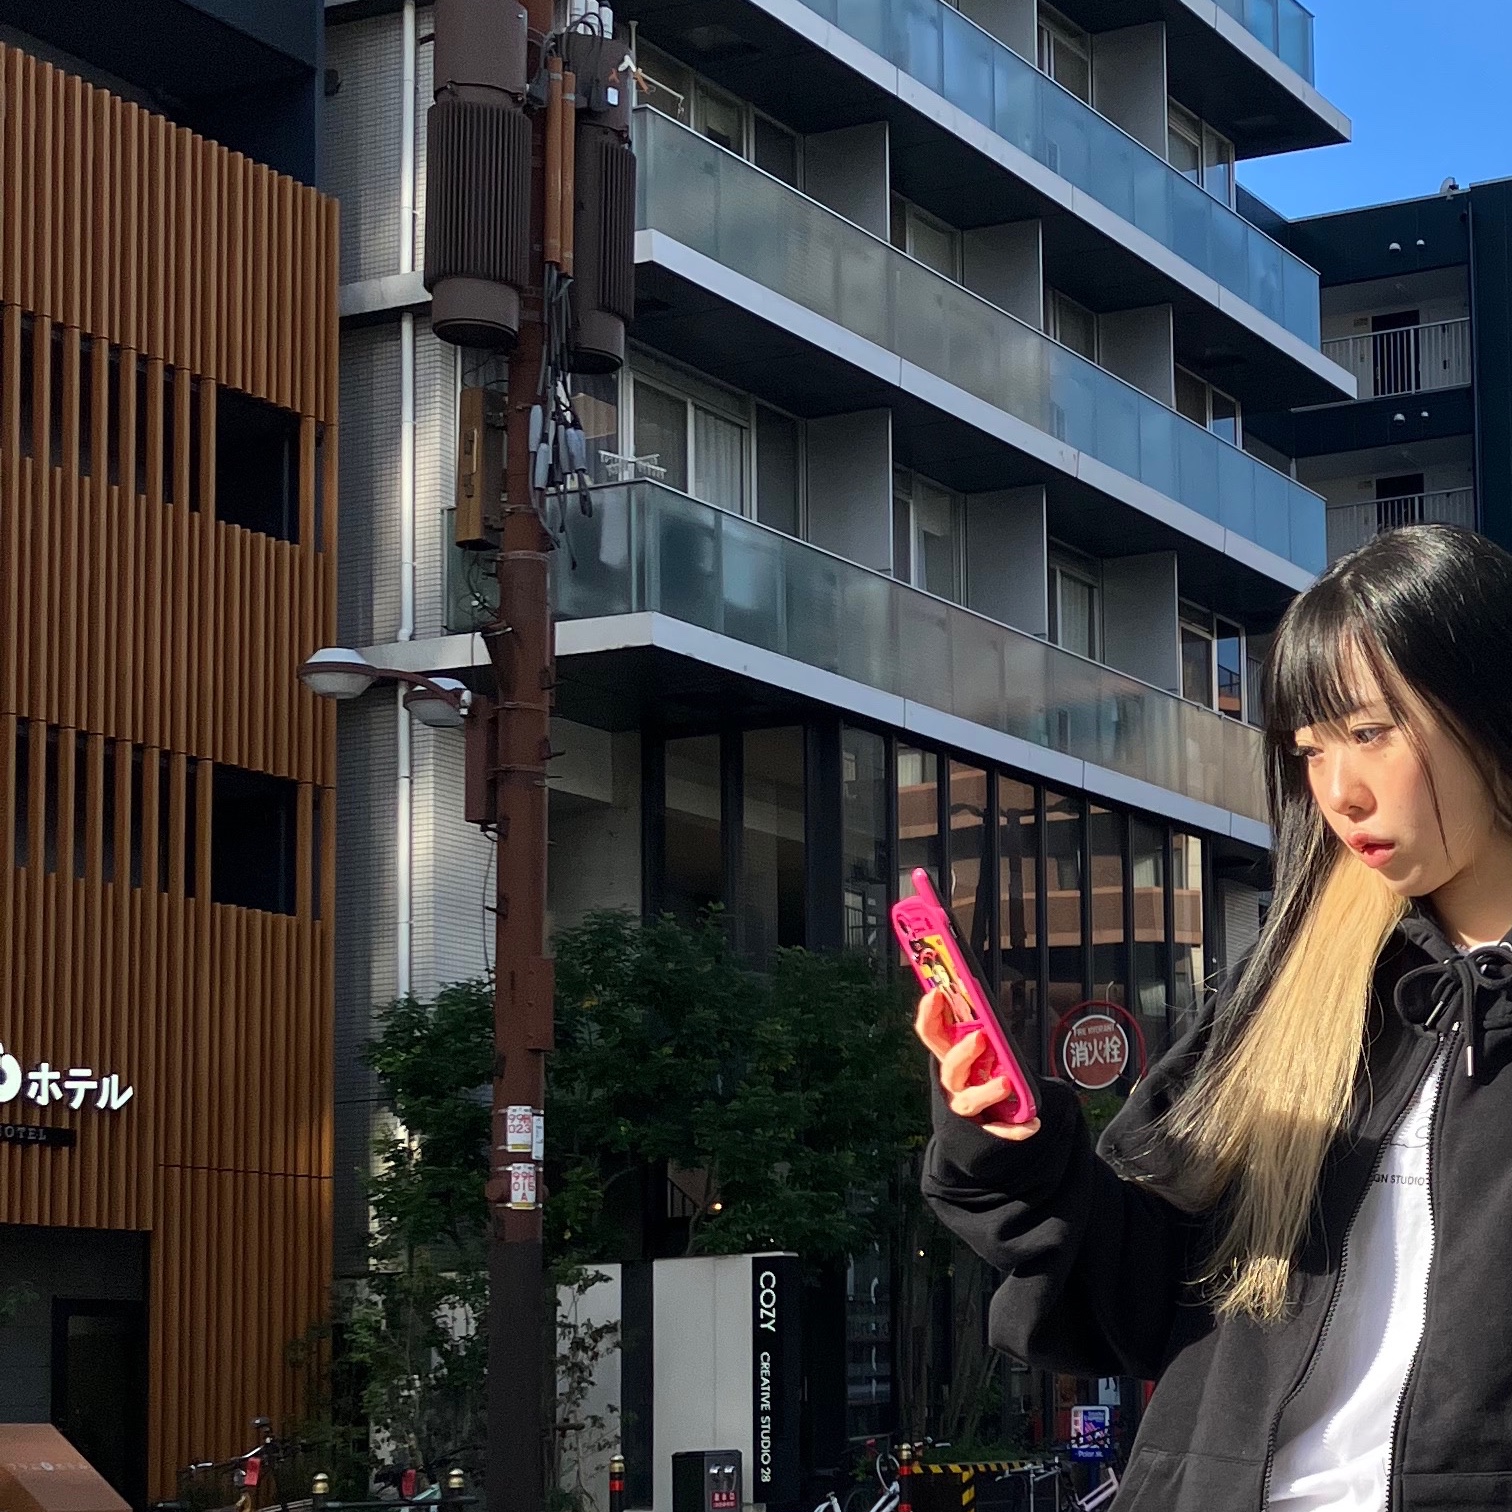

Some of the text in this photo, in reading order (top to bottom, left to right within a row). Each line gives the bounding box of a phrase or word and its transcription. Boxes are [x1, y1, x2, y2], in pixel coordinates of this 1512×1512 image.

[1069, 1035, 1122, 1068] 消火栓
[0, 1125, 47, 1140] OTEL
[1390, 1174, 1425, 1186] STUDIO
[759, 1270, 777, 1332] COZY
[760, 1351, 771, 1483] CREATIVE STUDIO 28
